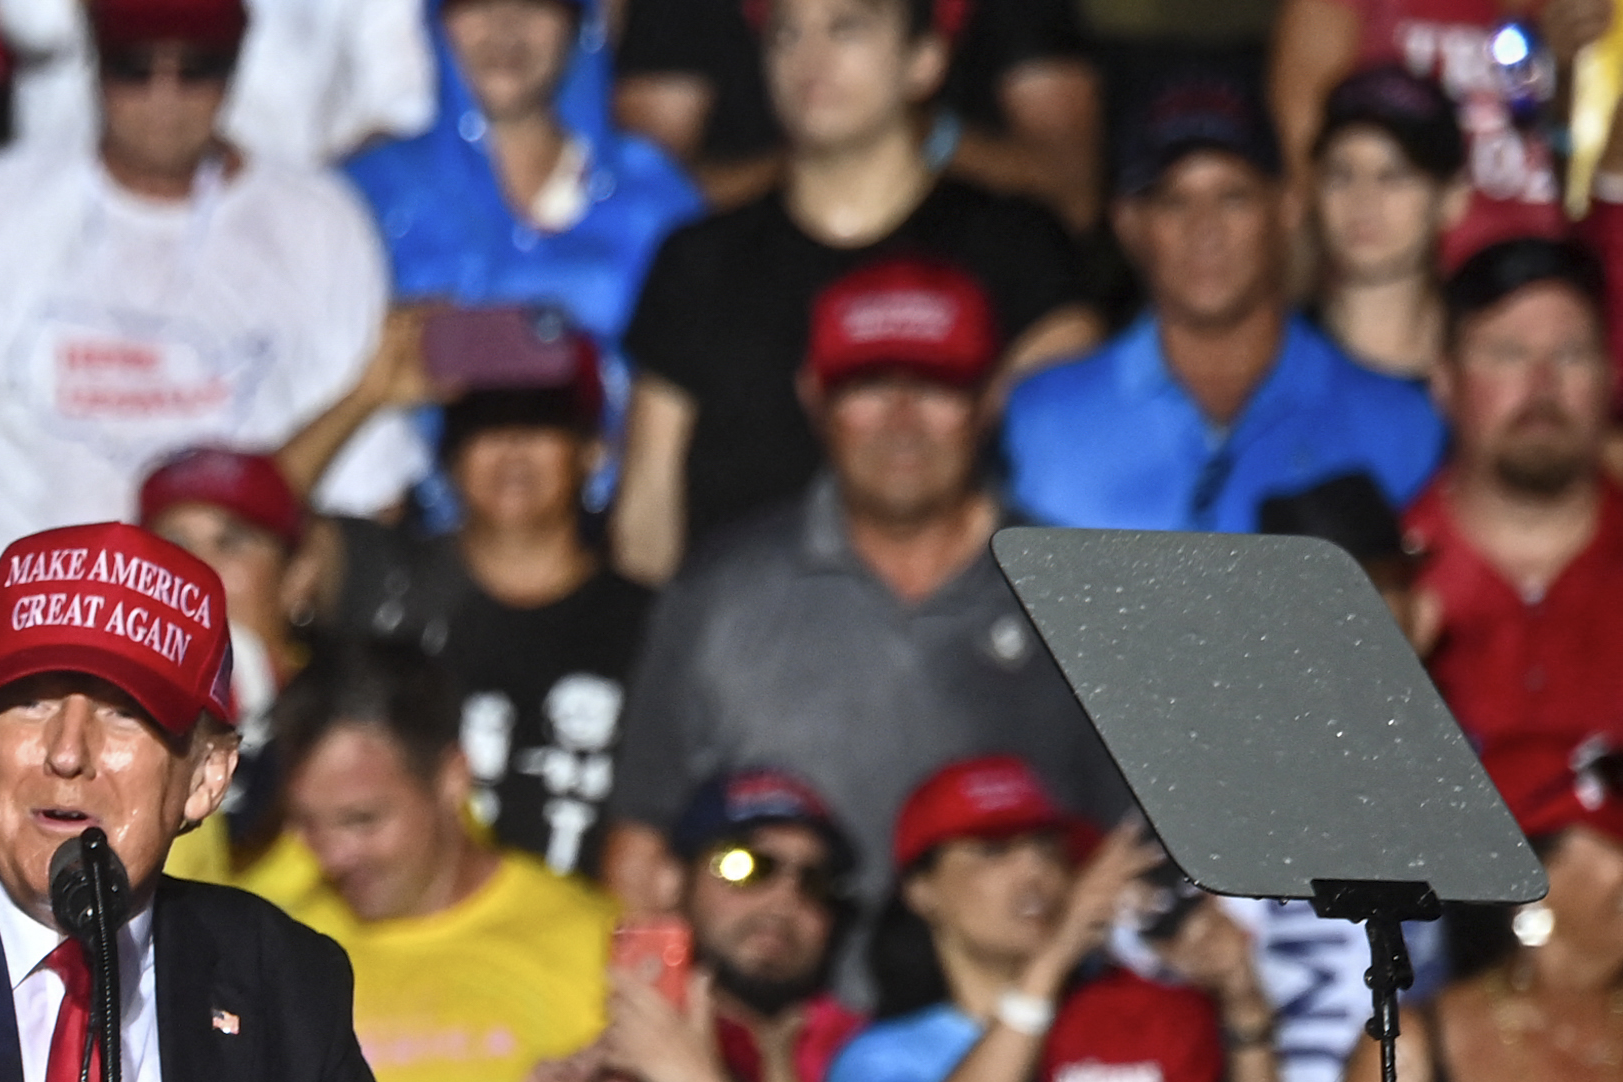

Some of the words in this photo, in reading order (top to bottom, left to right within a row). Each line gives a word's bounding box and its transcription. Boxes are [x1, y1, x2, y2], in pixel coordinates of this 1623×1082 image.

[4, 548, 88, 588] MAKE
[86, 548, 212, 630] AMERICA
[11, 591, 105, 631] GREAT
[104, 601, 193, 667] AGAIN
